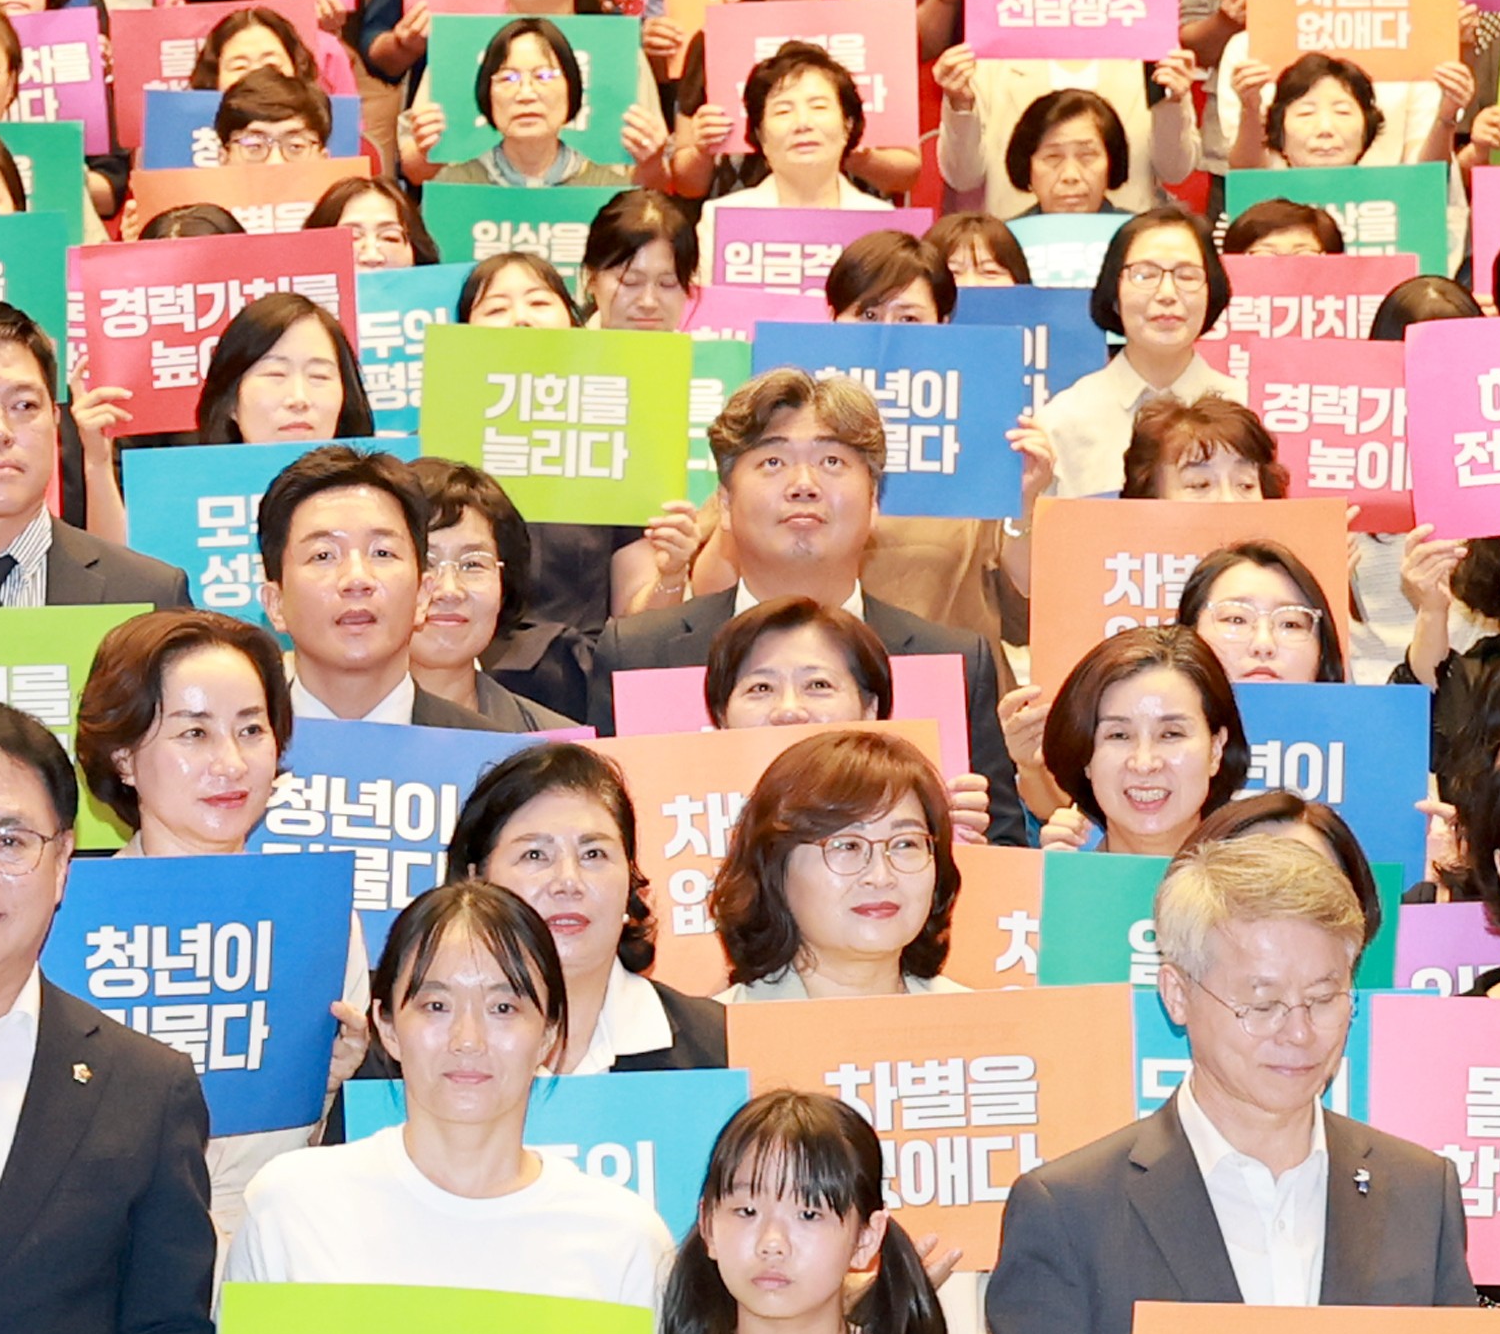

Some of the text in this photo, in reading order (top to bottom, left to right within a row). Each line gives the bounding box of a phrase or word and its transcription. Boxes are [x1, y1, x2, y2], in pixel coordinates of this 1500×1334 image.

[1298, 11, 1410, 49] 없애다
[485, 374, 628, 425] 기회를
[483, 427, 629, 479] 늘리다
[1309, 439, 1412, 491] 높이
[266, 773, 456, 842] 청년이
[86, 921, 271, 997] 청년이
